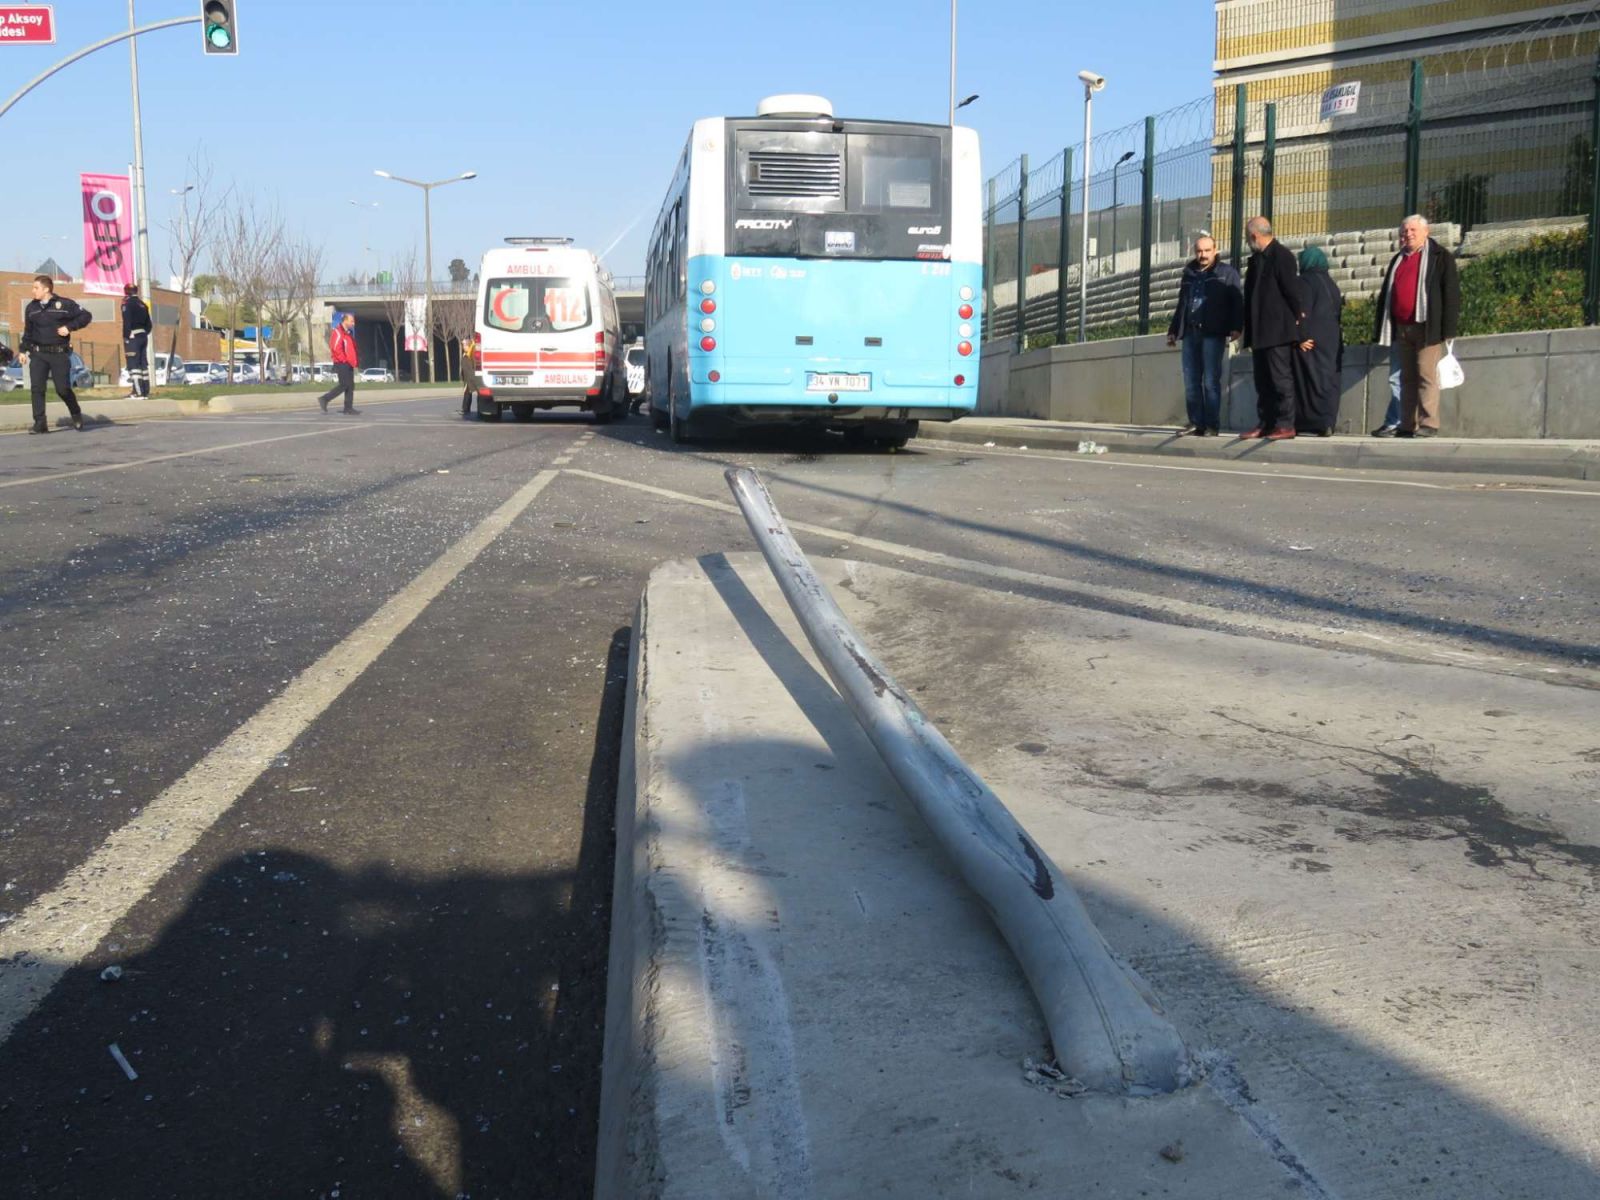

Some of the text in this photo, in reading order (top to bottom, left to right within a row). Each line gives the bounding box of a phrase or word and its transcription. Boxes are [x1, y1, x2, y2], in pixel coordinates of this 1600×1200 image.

[8, 13, 43, 26] Aksoy
[0, 26, 26, 37] desi
[507, 264, 555, 275] AMBULA
[544, 374, 589, 385] AMBULANS
